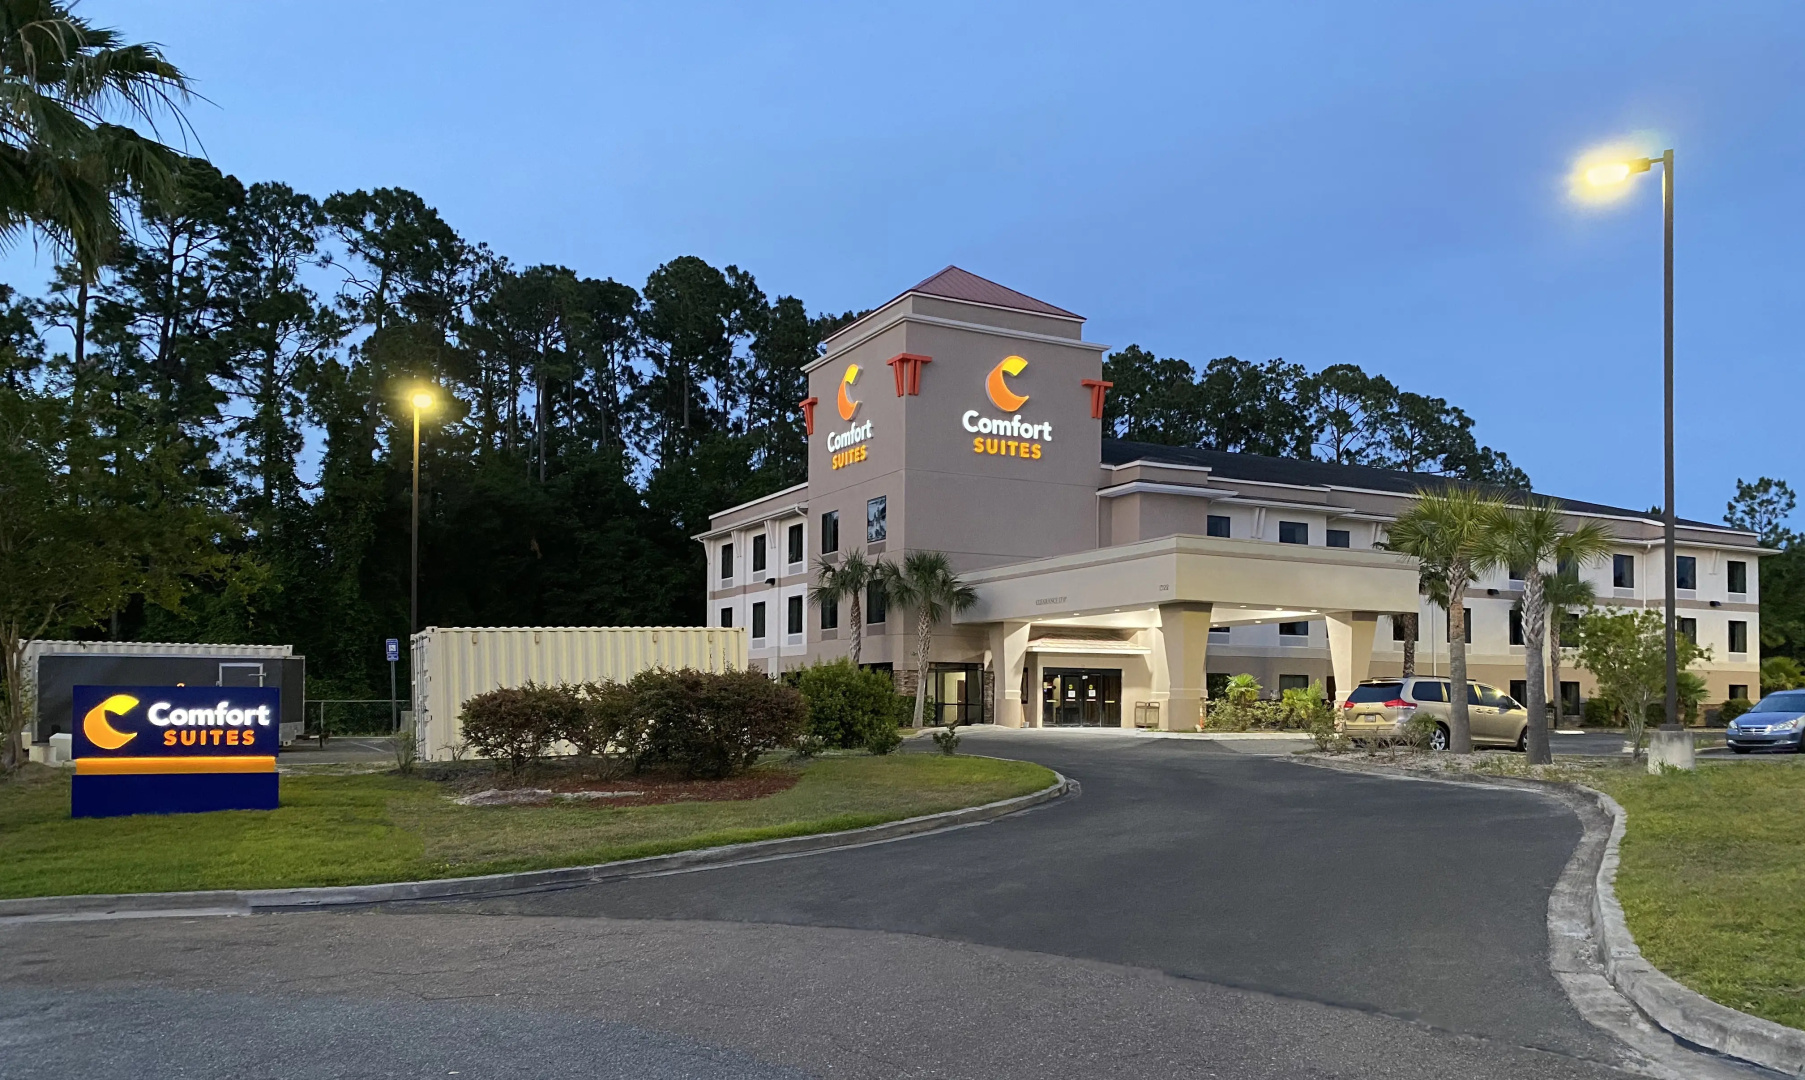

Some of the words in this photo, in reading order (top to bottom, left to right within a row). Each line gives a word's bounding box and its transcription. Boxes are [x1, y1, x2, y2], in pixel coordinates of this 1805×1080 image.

[827, 419, 872, 452] Comfort
[962, 410, 1052, 441] Comfort
[832, 444, 866, 470] SUITES
[973, 437, 1042, 459] SUITES
[147, 701, 270, 726] Comfort
[163, 729, 255, 746] SUITES
